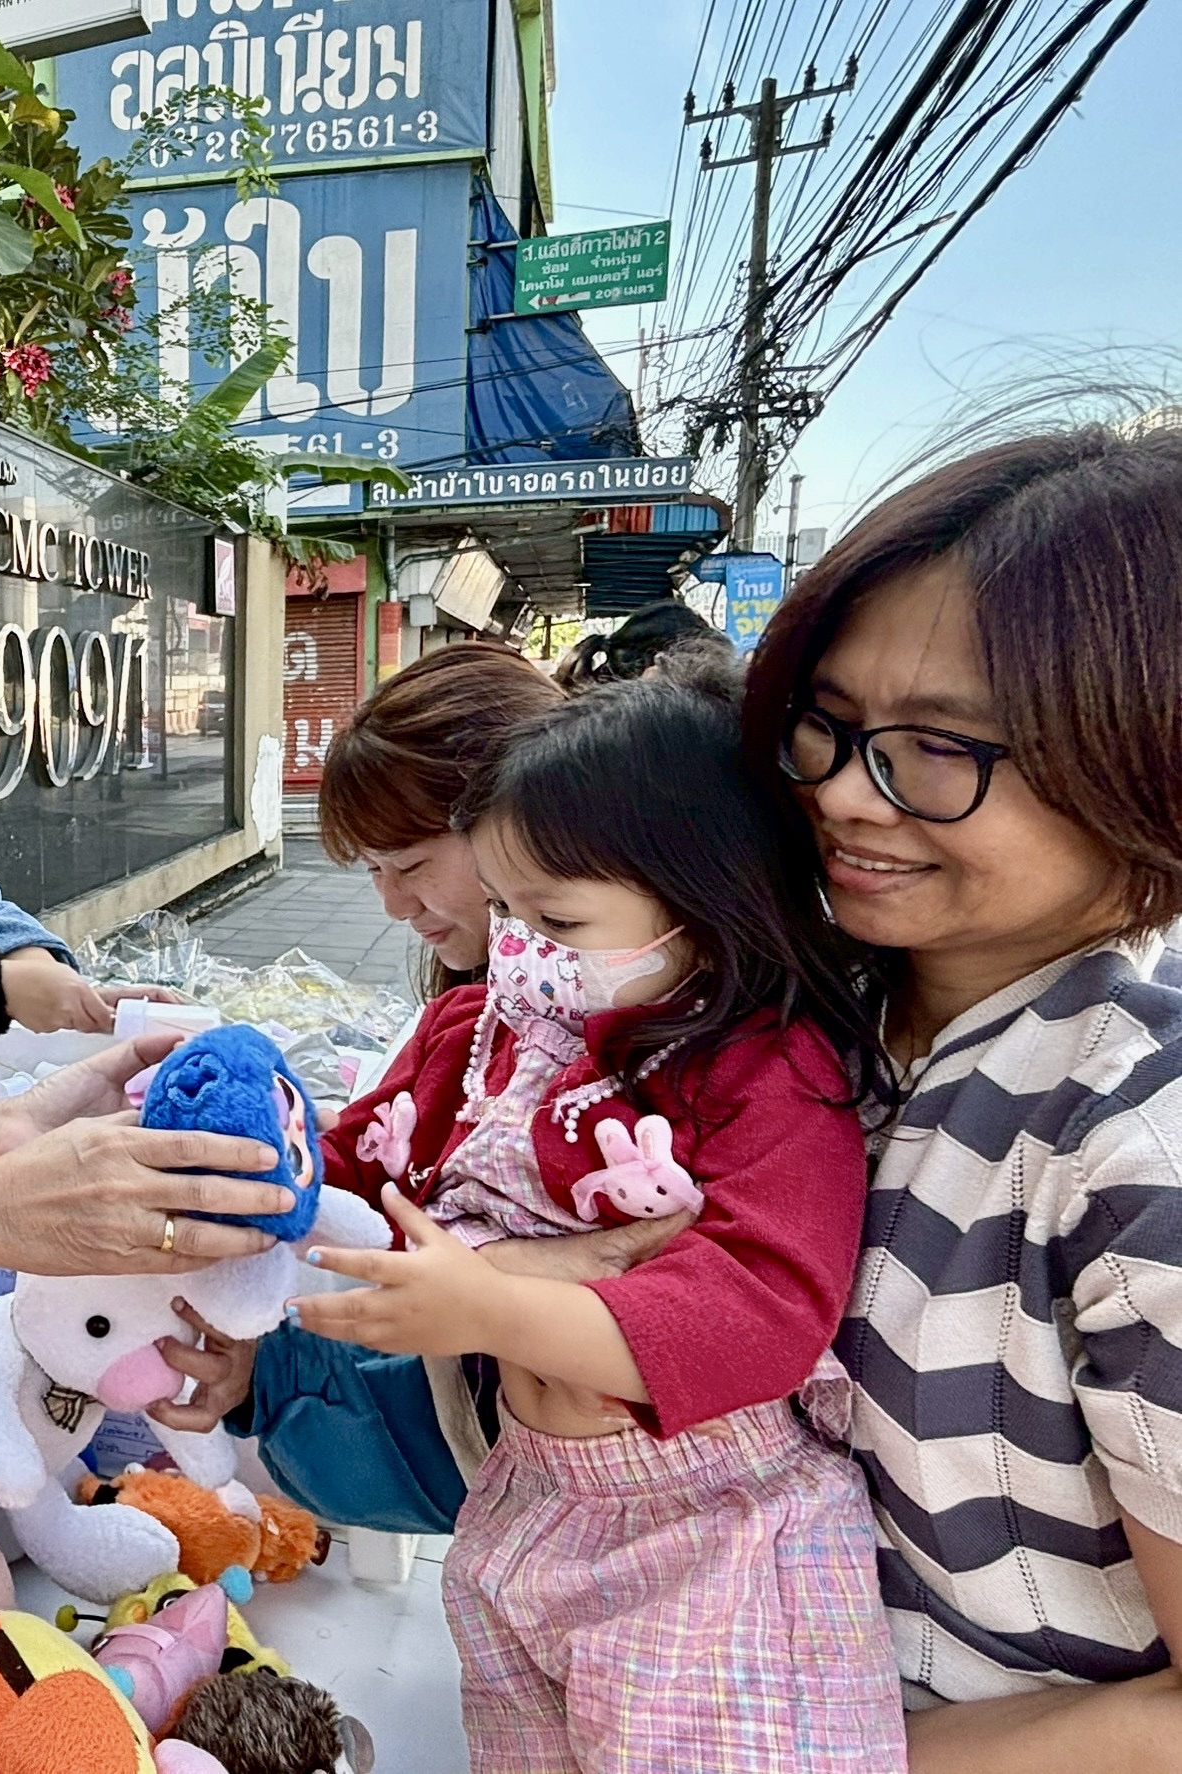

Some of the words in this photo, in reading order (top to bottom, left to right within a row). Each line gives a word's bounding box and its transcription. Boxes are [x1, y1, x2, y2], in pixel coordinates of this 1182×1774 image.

[654, 230, 666, 246] 2
[623, 283, 655, 296] เมตร
[69, 531, 154, 600] TOWER
